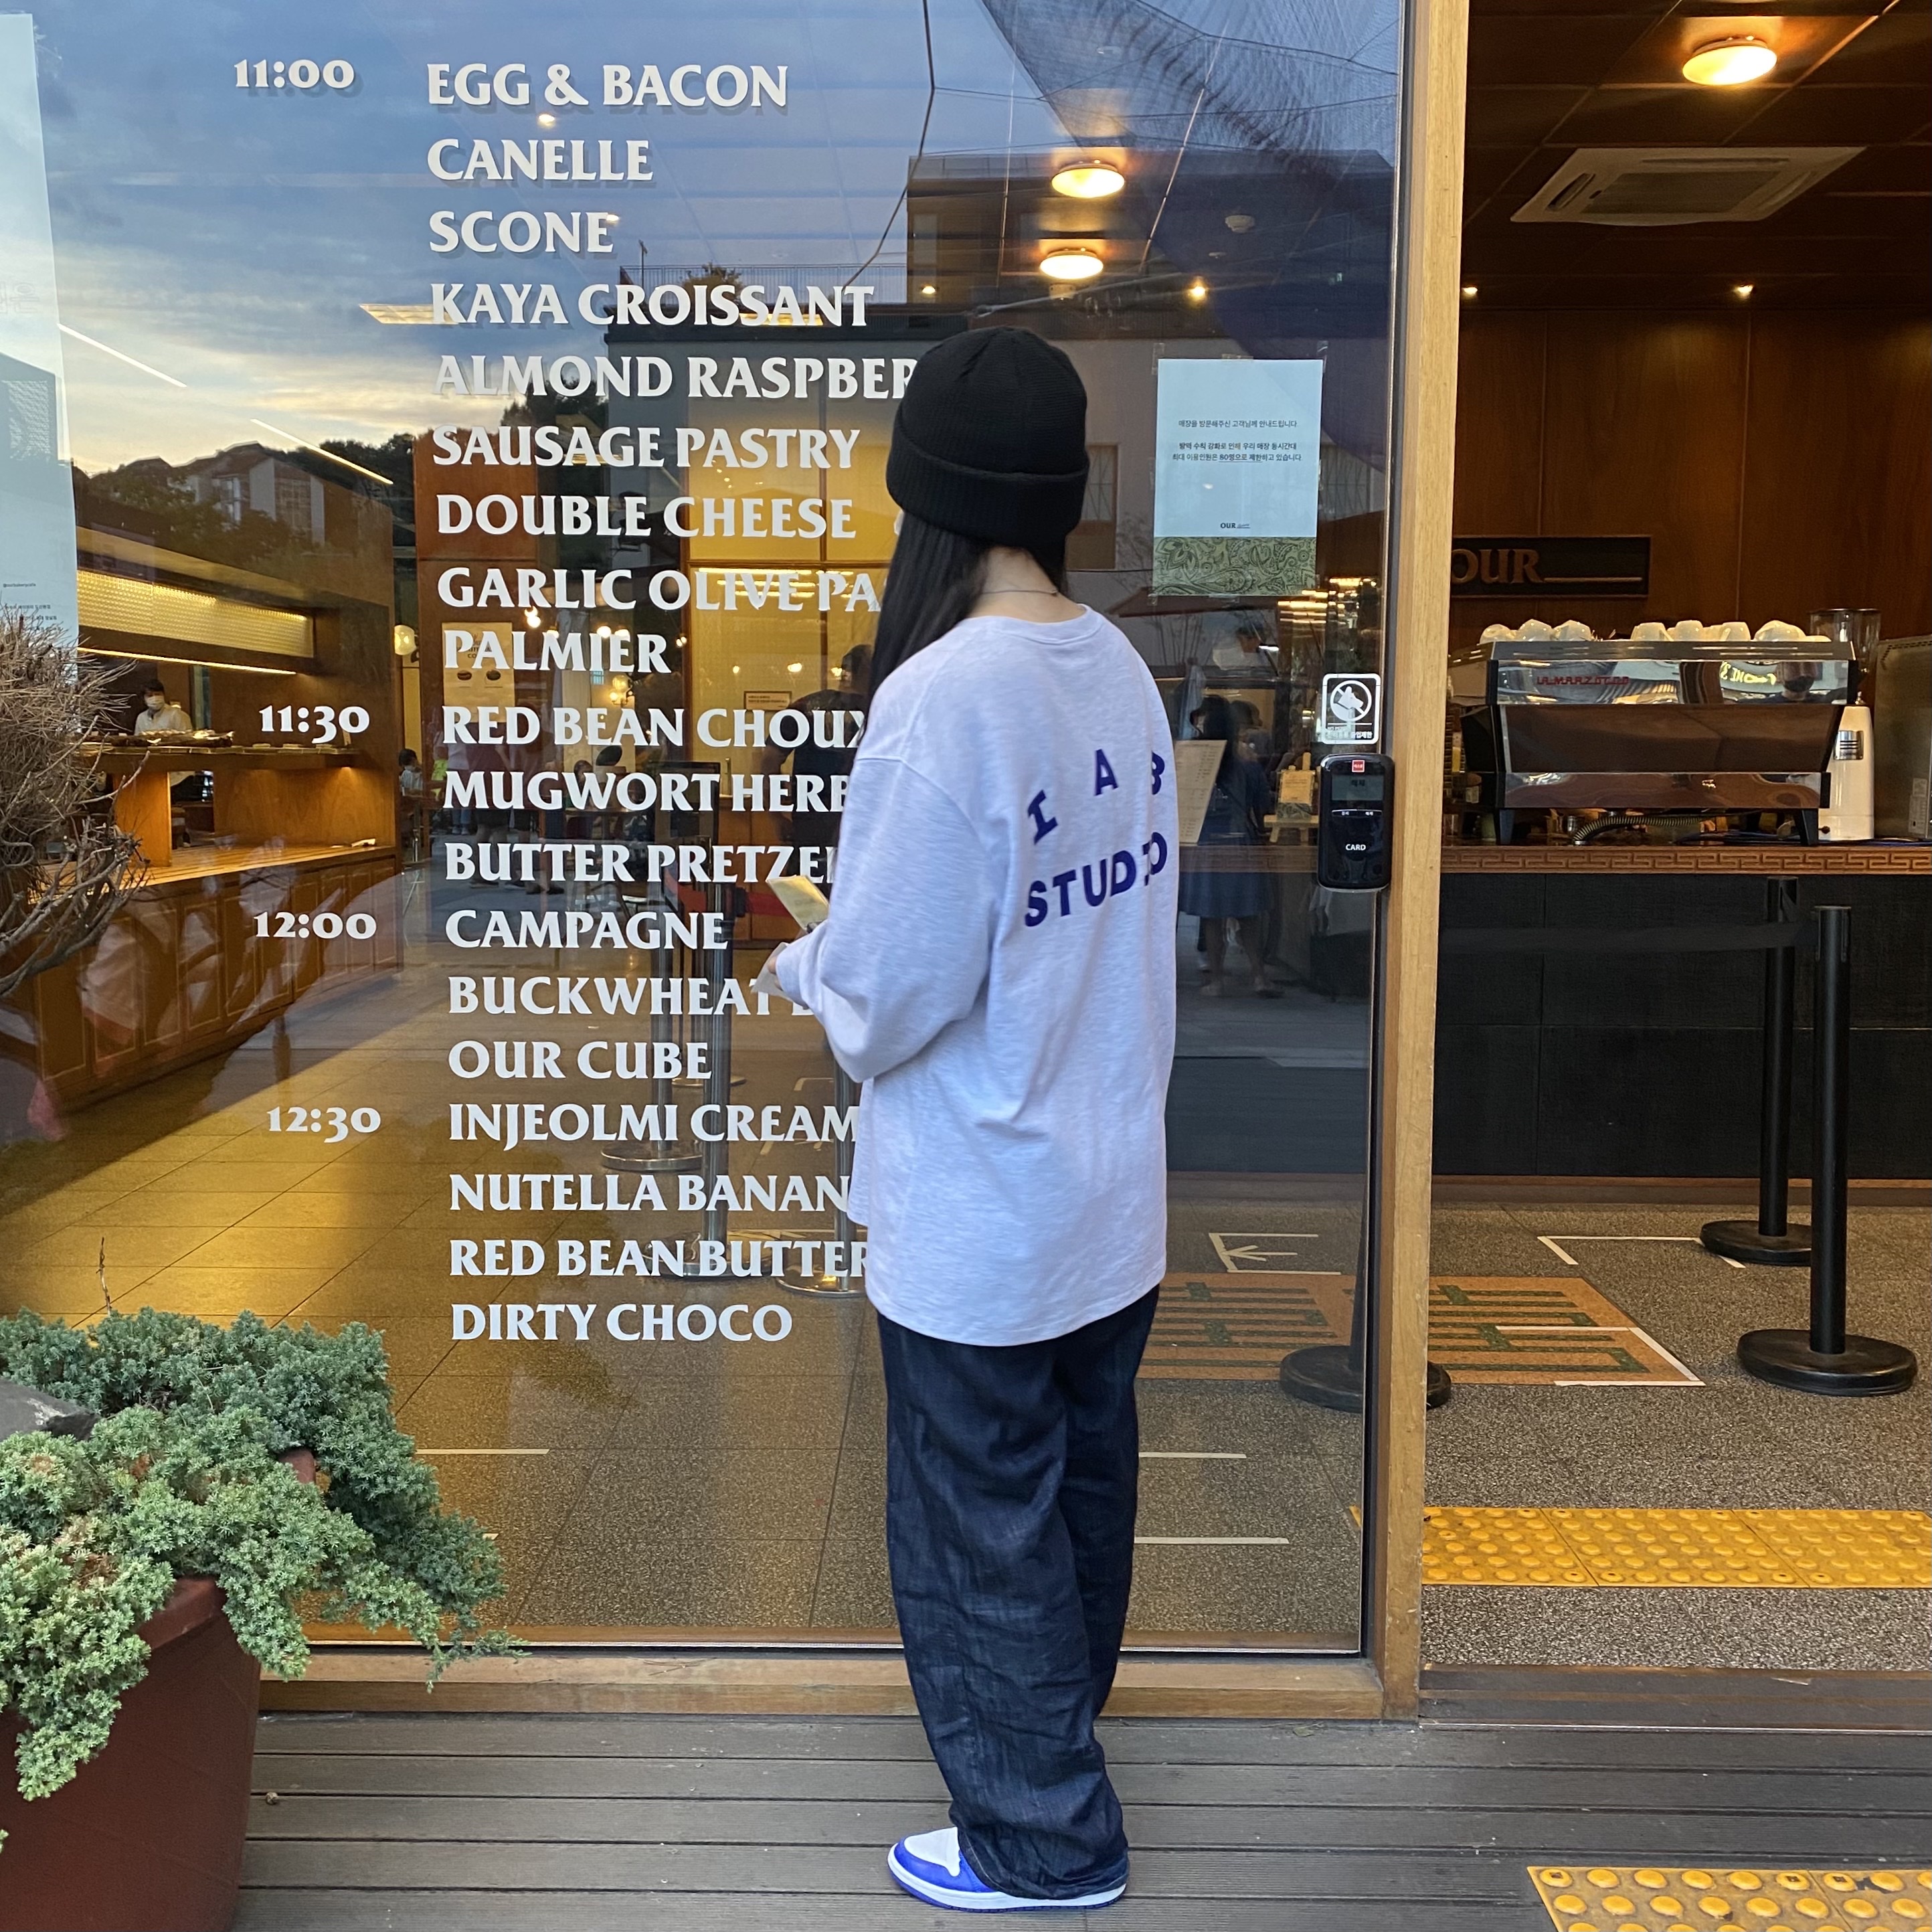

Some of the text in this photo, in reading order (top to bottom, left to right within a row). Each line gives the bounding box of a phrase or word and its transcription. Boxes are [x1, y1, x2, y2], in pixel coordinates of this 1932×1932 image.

[234, 59, 355, 88] 11:00
[428, 64, 788, 107] EGG & BACON
[428, 139, 653, 181] CANELLE
[430, 211, 613, 253] SCONE
[432, 284, 874, 326] KAYA CROISSANT
[434, 355, 673, 396] ALMOND
[1178, 420, 1197, 428] 매장을
[1199, 420, 1231, 428] 방문해주신
[1232, 420, 1257, 428] 고객님께
[433, 426, 859, 468] SAUSAGE PASTRY
[1219, 454, 1248, 462] 80명으로
[1249, 454, 1274, 462] 제한하고
[1243, 442, 1255, 450] 우리
[1257, 442, 1269, 450] 매장
[1271, 442, 1297, 450] 동시간대
[437, 494, 856, 538] DOUBLE CHEESE
[1452, 548, 1544, 584] OUR
[438, 567, 888, 612] GARLIC OLIVE PA
[443, 629, 671, 674] PALMIER
[260, 705, 370, 743] 11:30
[443, 705, 540, 746] RED
[553, 707, 685, 748] BEAN
[444, 771, 719, 812] MUGWORT
[446, 843, 634, 882] BUTTER
[1345, 843, 1367, 851] CARD
[254, 912, 376, 940] 12:00
[446, 909, 729, 950] CAMPAGNE
[448, 1041, 711, 1080] OUR CUBE
[266, 1106, 381, 1143] 12:30
[450, 1104, 859, 1151] INJEOLMI CREAM
[450, 1174, 850, 1213] NUTELLA BANAN
[450, 1240, 545, 1276] RED
[558, 1241, 685, 1277] BEAN
[452, 1304, 792, 1342] DIRTY CHOCO
